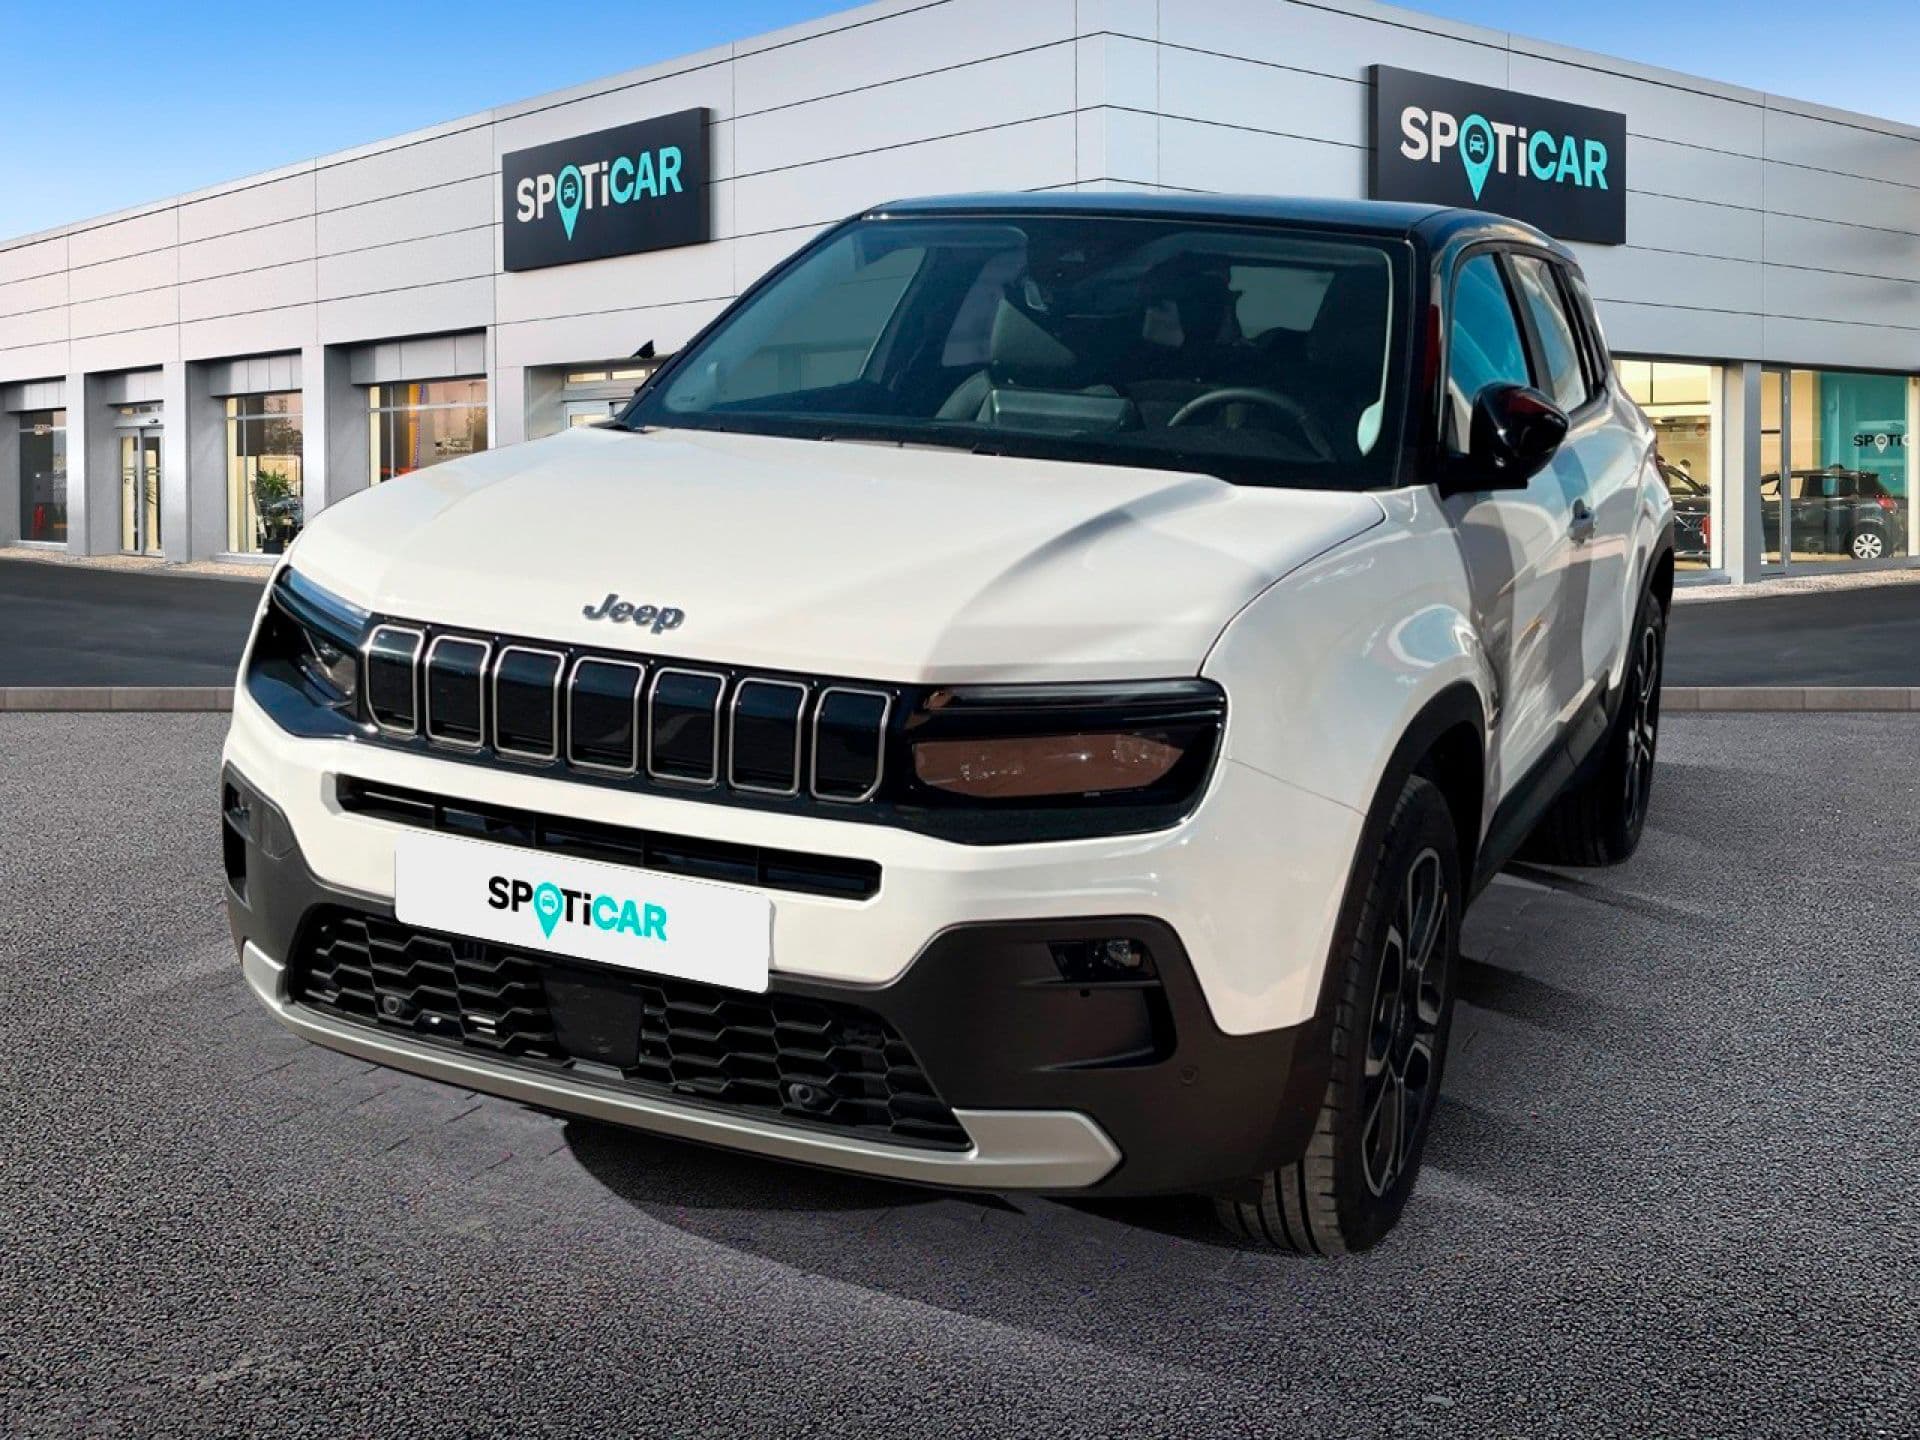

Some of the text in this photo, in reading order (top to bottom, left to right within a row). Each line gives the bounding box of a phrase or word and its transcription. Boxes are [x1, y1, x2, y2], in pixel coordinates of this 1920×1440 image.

[516, 146, 683, 241] SPOTiCAR
[1400, 106, 1609, 202] SPOTiCAR
[582, 593, 685, 635] Jeep
[488, 875, 668, 941] SPOTiCAR
